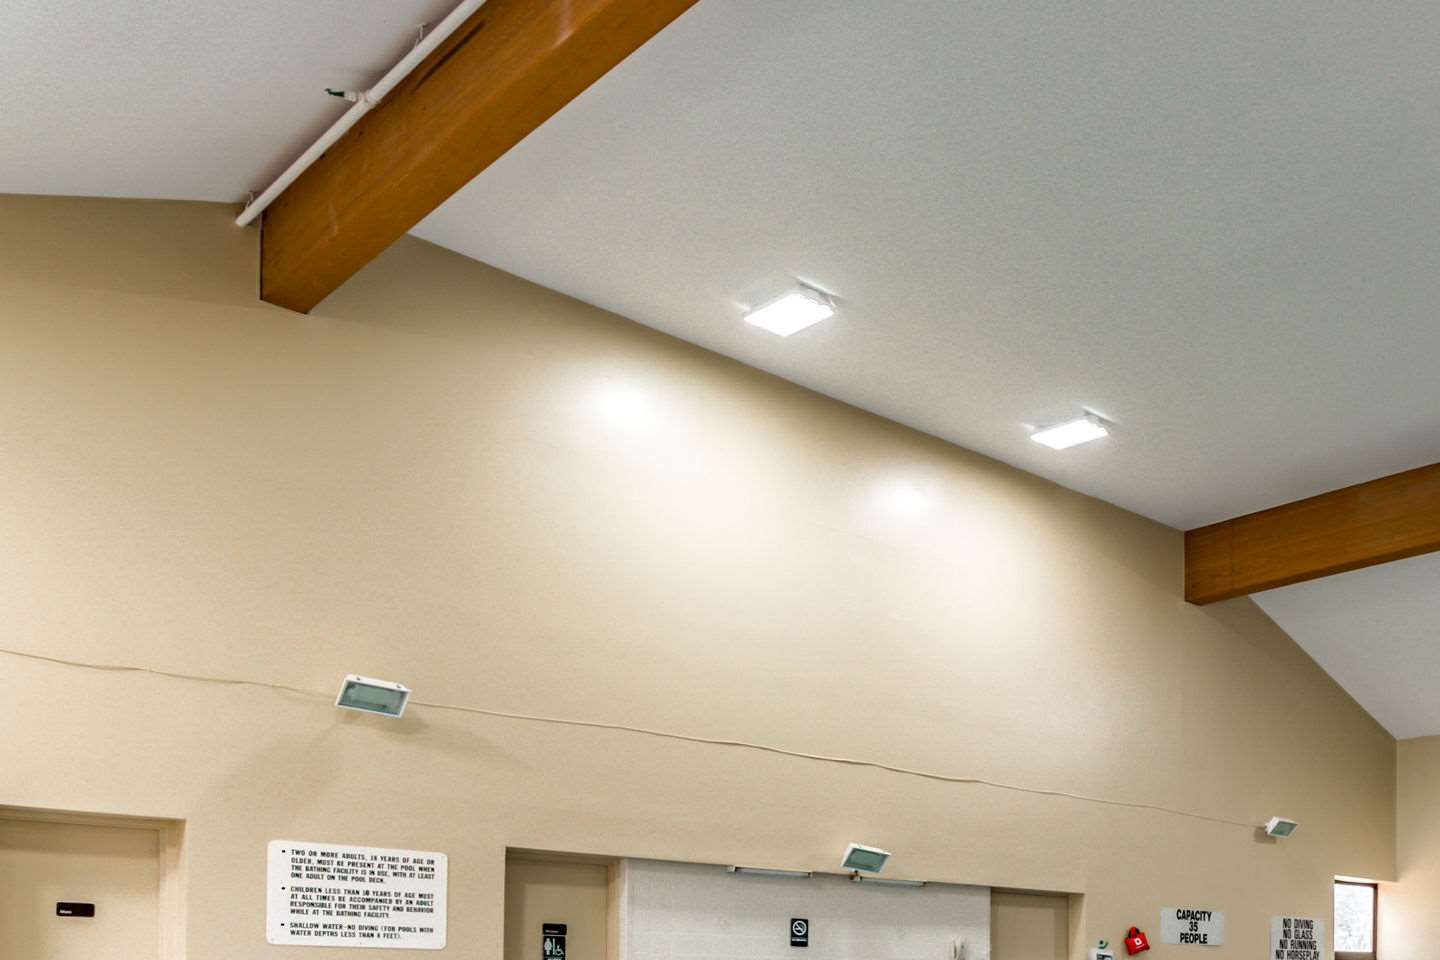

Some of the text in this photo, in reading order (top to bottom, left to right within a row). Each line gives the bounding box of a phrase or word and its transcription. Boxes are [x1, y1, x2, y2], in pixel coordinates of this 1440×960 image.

[1176, 908, 1212, 922] CAPACITY
[1189, 921, 1199, 932] 35
[1283, 918, 1314, 930] NO DIVING
[1180, 932, 1208, 944] PEOPLE
[1283, 929, 1313, 940] NO GLASS
[1279, 939, 1317, 951] NO RUNNING
[1275, 949, 1320, 960] NO HORSEPLAY
